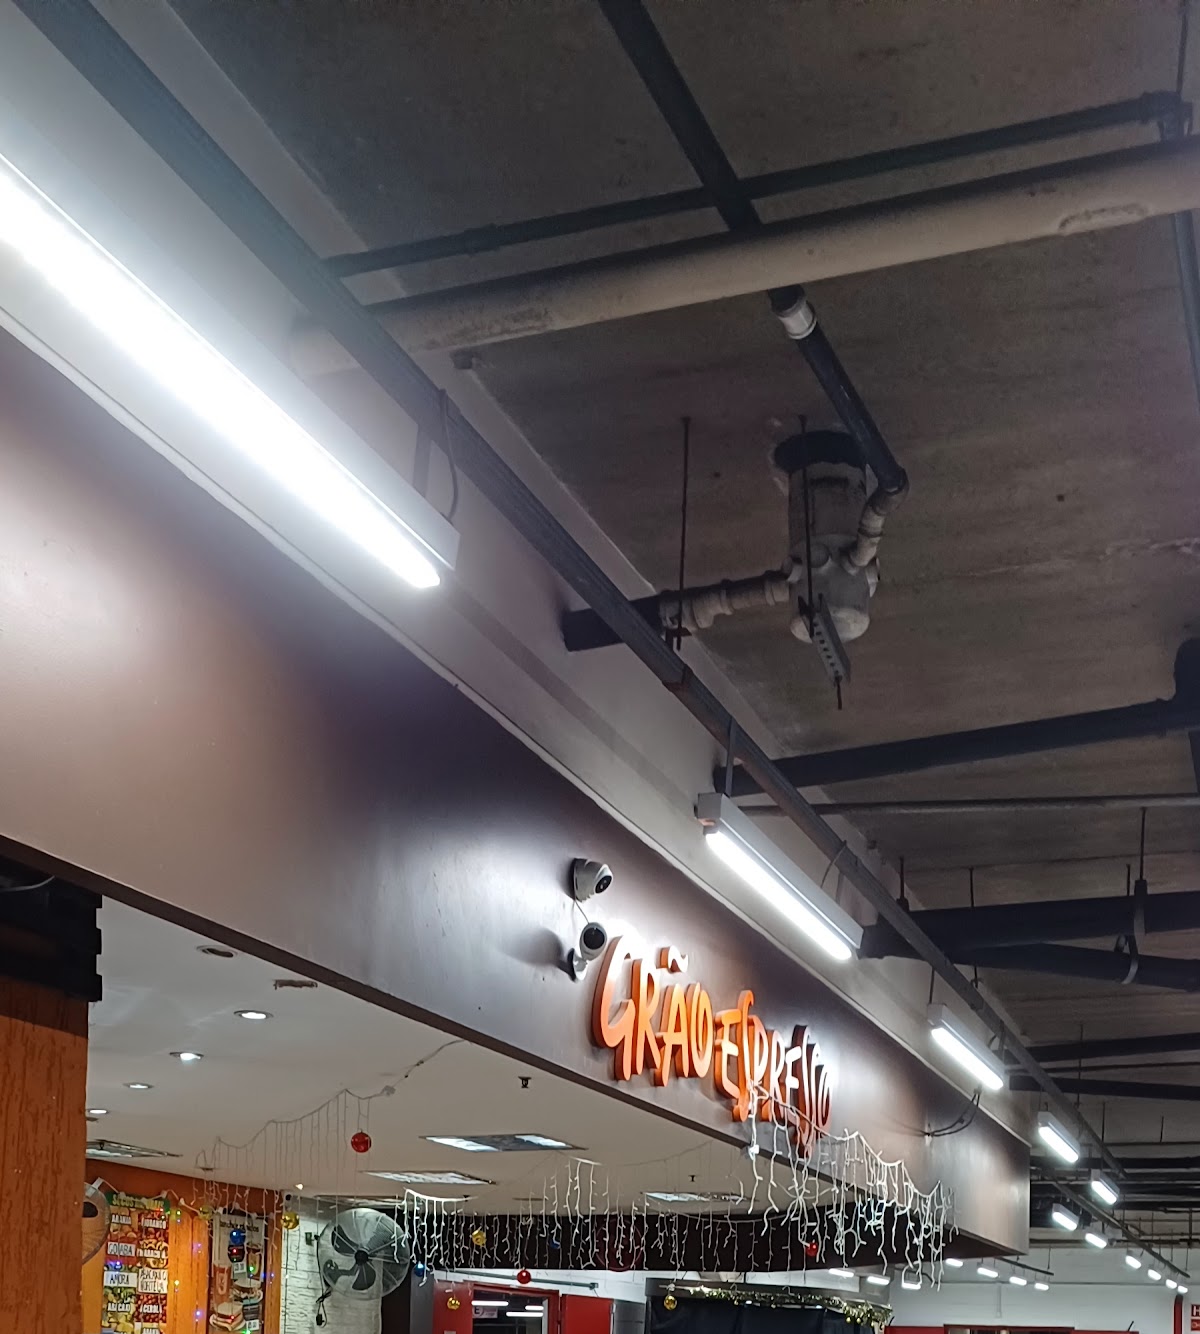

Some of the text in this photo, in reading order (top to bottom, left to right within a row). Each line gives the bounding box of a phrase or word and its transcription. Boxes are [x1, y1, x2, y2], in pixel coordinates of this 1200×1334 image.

[592, 934, 834, 1156] GRÃO ESPRESSO
[108, 1242, 133, 1256] GOIABA
[109, 1273, 130, 1286] AMORA
